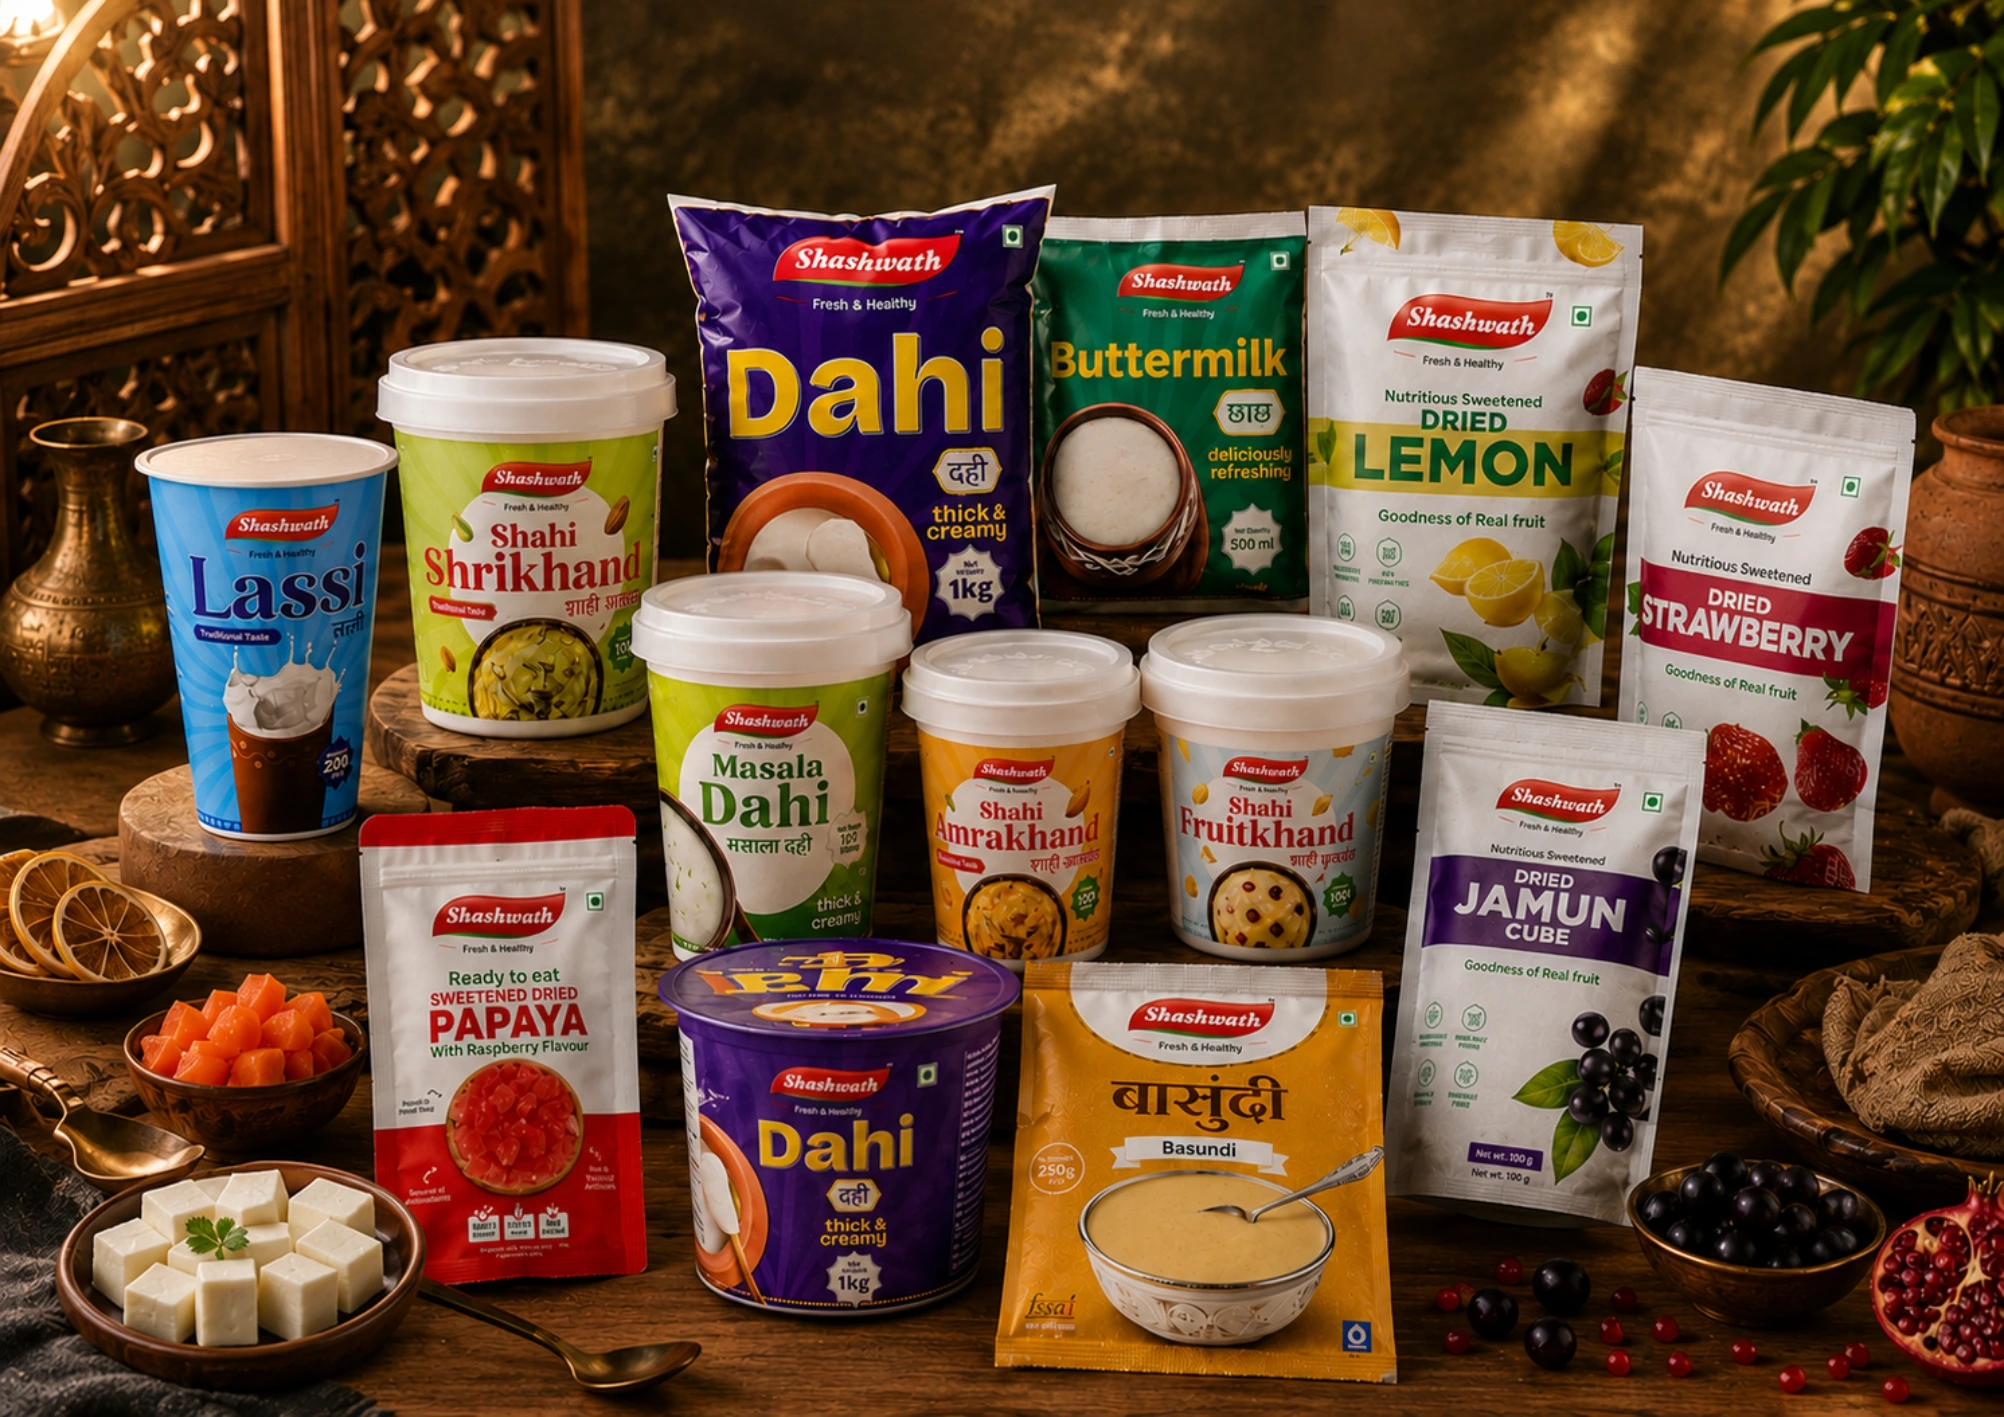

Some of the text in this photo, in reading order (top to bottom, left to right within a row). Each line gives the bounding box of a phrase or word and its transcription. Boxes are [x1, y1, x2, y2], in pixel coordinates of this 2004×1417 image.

[796, 246, 943, 273] Shashwath
[1132, 272, 1232, 292] Shashwath
[812, 296, 917, 312] Fresh & Healthy
[1142, 308, 1215, 320] Fresh & Healthy
[1406, 306, 1536, 336] Shashwath
[1050, 336, 1288, 378] Buttermilk
[1423, 356, 1504, 371] Fresh & Healthy
[726, 326, 1005, 438] Dahi
[1384, 390, 1542, 408] Nutritious Sweetened
[1421, 410, 1508, 433] DRIED
[1208, 446, 1292, 462] deliciously
[1354, 434, 1573, 487] LEMON
[494, 469, 583, 486] Shashwath
[946, 454, 989, 487] दही
[1210, 464, 1292, 482] refreshing
[529, 503, 536, 512] &
[1702, 480, 1800, 516] Shashwath
[932, 503, 1006, 522] thick &
[1378, 509, 1546, 529] Goodness of Real fruit
[238, 515, 329, 533] Shashwath
[926, 523, 1007, 542] creamy
[1710, 522, 1734, 536] Fresh
[490, 521, 577, 549] Shahi
[1230, 537, 1274, 550] 500 ml
[424, 540, 640, 592] Shrikhand
[1671, 550, 1812, 586] Nutritious Sweetened
[189, 540, 367, 620] Lassi
[948, 577, 994, 603] 1kg
[1708, 588, 1772, 616] DRIED
[1642, 594, 1854, 662] STRAWBERRY
[1665, 663, 1798, 702] Goodness of Real fruit
[725, 711, 808, 728] Shashwath
[323, 754, 348, 774] 200
[712, 754, 823, 780] Masala
[699, 780, 830, 828] Dahi
[980, 800, 1043, 821] Shahi
[1229, 796, 1292, 818] Shahi
[1511, 786, 1606, 816] Shashwath
[935, 813, 1099, 850] Amrakhand
[1180, 806, 1354, 848] Fruitkhand
[1490, 842, 1606, 867] Nutritious Sweetened
[1514, 869, 1574, 890] DRIED
[817, 894, 852, 912] thick
[1454, 882, 1626, 933] JAMUN
[446, 906, 554, 928] Shashwath
[811, 910, 862, 930] creamy
[1504, 922, 1570, 946] CUBE
[463, 944, 488, 954] Fresh
[490, 944, 498, 954] &
[448, 968, 560, 987] Ready to eat
[1464, 958, 1600, 986] Goodness of Real fruit
[430, 987, 578, 1006] SWEETENED DRIED
[429, 1004, 588, 1043] PAPAYA
[1144, 1006, 1262, 1028] Shashwath
[430, 1040, 589, 1058] With Raspberry Flavour
[1158, 1041, 1242, 1055] Fresh & Healthy
[784, 1074, 878, 1092] Shashwath
[1111, 1074, 1288, 1132] बासुंदी
[758, 1114, 914, 1172] Dahi
[1162, 1142, 1237, 1158] Basundi
[1510, 1153, 1526, 1163] 100
[1038, 1164, 1076, 1180] 250g
[1507, 1172, 1522, 1182] 100
[838, 1183, 870, 1206] दही
[825, 1218, 886, 1232] thick &
[820, 1232, 887, 1248] creamy
[838, 1275, 870, 1294] 1kg
